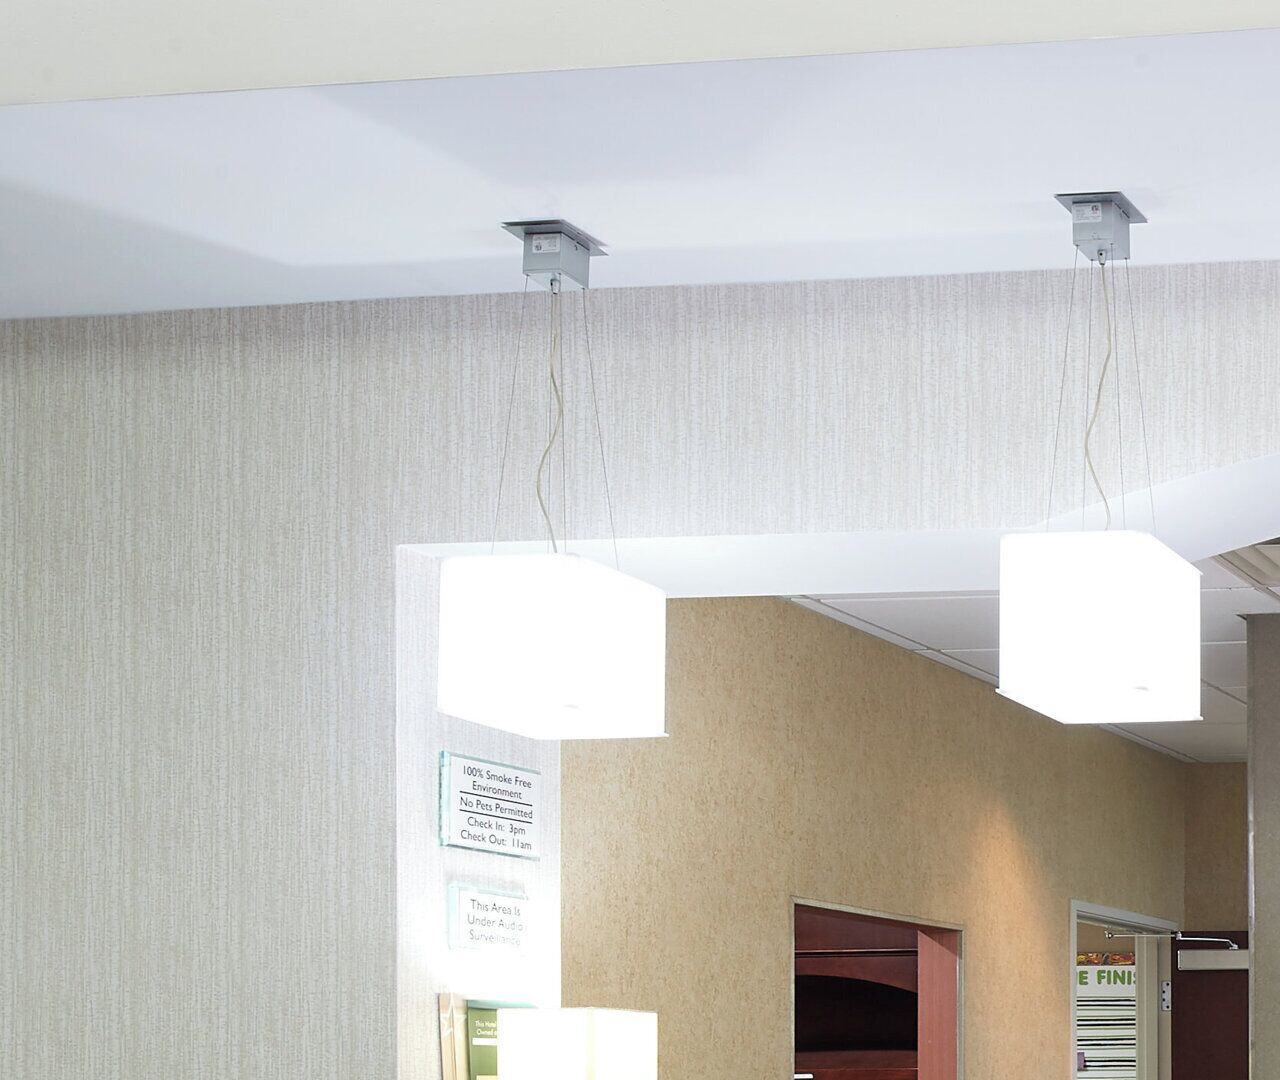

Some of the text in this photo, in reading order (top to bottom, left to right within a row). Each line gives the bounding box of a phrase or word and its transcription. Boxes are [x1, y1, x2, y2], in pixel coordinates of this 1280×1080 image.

[463, 765, 532, 789] 100% Smoke Free
[472, 780, 522, 799] Environment
[460, 797, 533, 819] No Pets Permitted
[467, 816, 526, 836] Check In: 3pm
[460, 829, 532, 850] Check Out: 11am
[470, 898, 489, 912] This
[491, 902, 512, 915] Area
[467, 914, 524, 931] Under Audio
